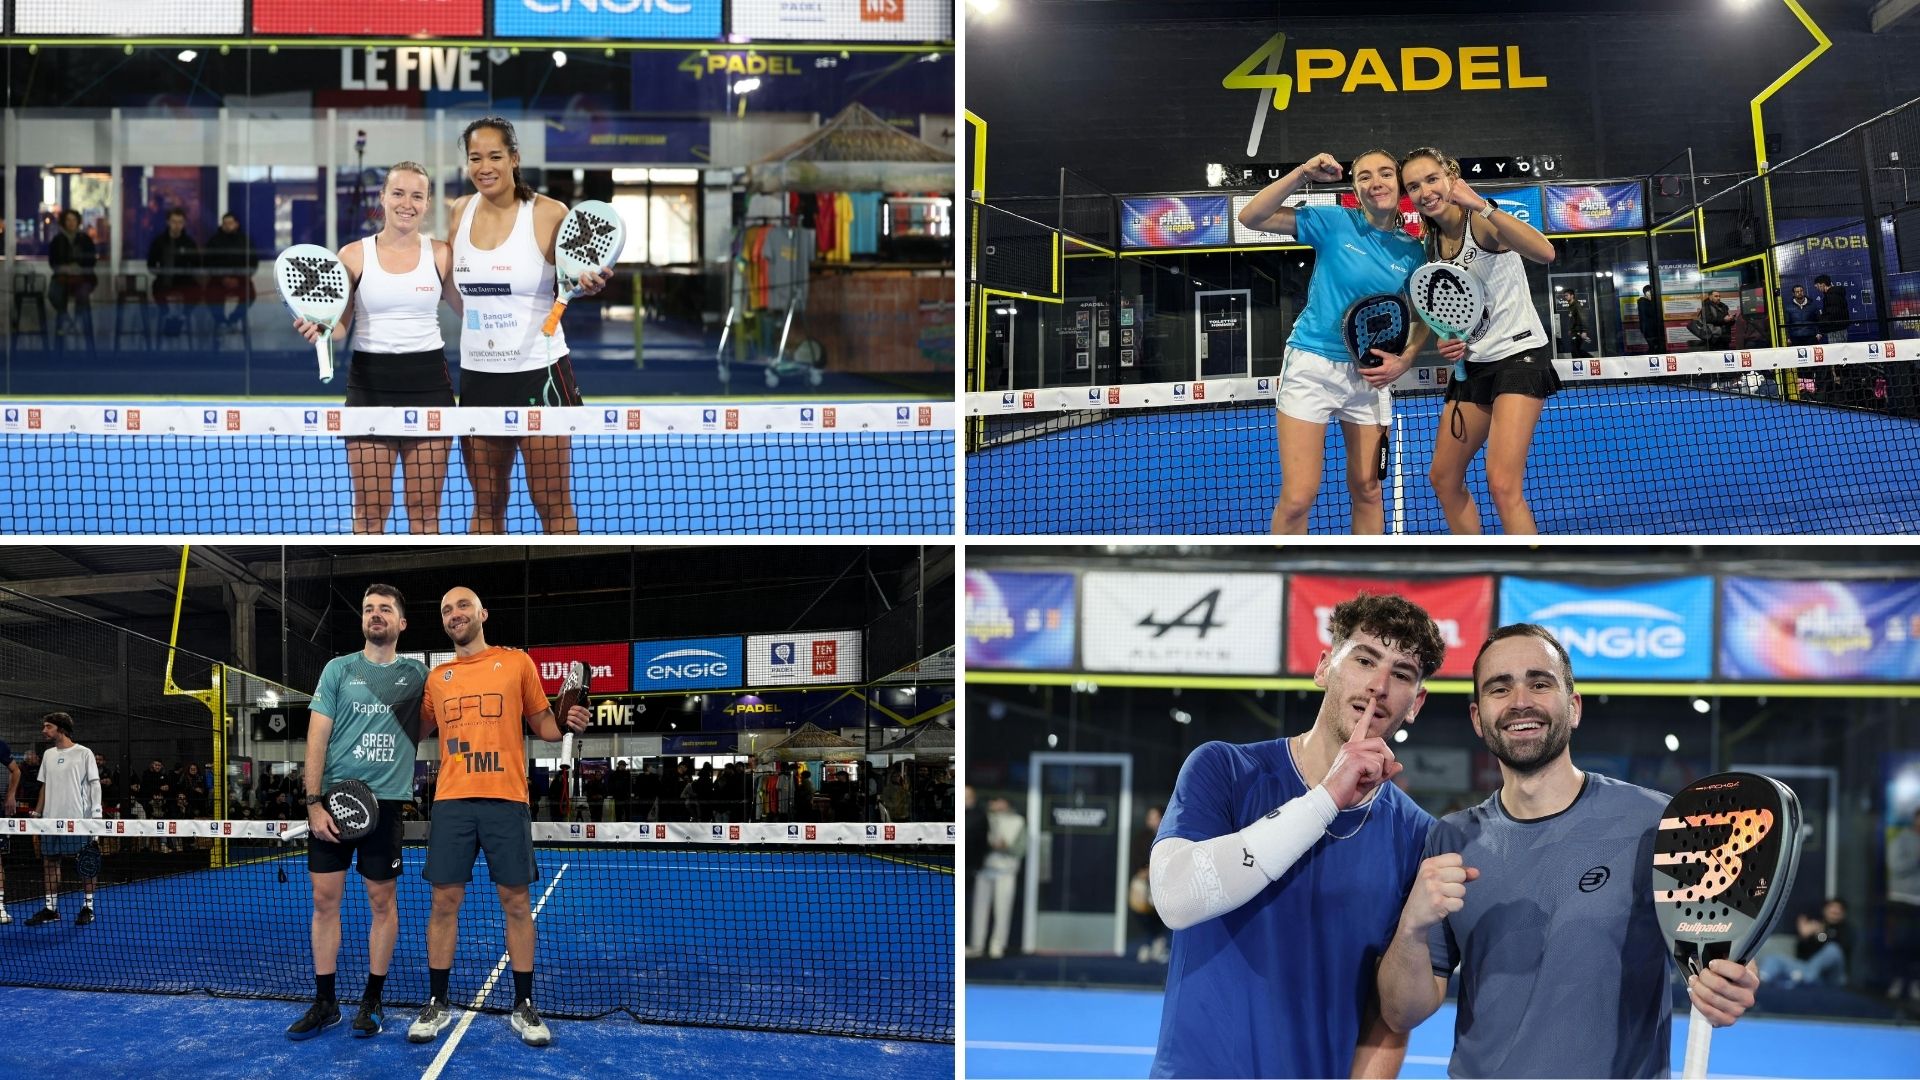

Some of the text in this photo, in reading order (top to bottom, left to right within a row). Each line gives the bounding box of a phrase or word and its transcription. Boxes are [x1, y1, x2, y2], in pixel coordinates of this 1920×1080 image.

[341, 46, 484, 91] LE FIVE
[677, 53, 801, 80] 4PADEL
[1222, 32, 1548, 157] 4PADEL
[482, 312, 512, 321] Banque
[496, 320, 518, 328] Tahiti
[816, 644, 832, 655] TEN
[541, 660, 613, 680] Wion
[816, 660, 833, 671] NIS
[352, 702, 394, 716] Raptor
[597, 704, 635, 726] FIVE
[723, 703, 782, 716] 4PADEL
[362, 733, 396, 748] GREEN
[366, 748, 394, 762] WEEZ
[464, 752, 504, 774] TML
[1676, 921, 1733, 935] Bullpadel
